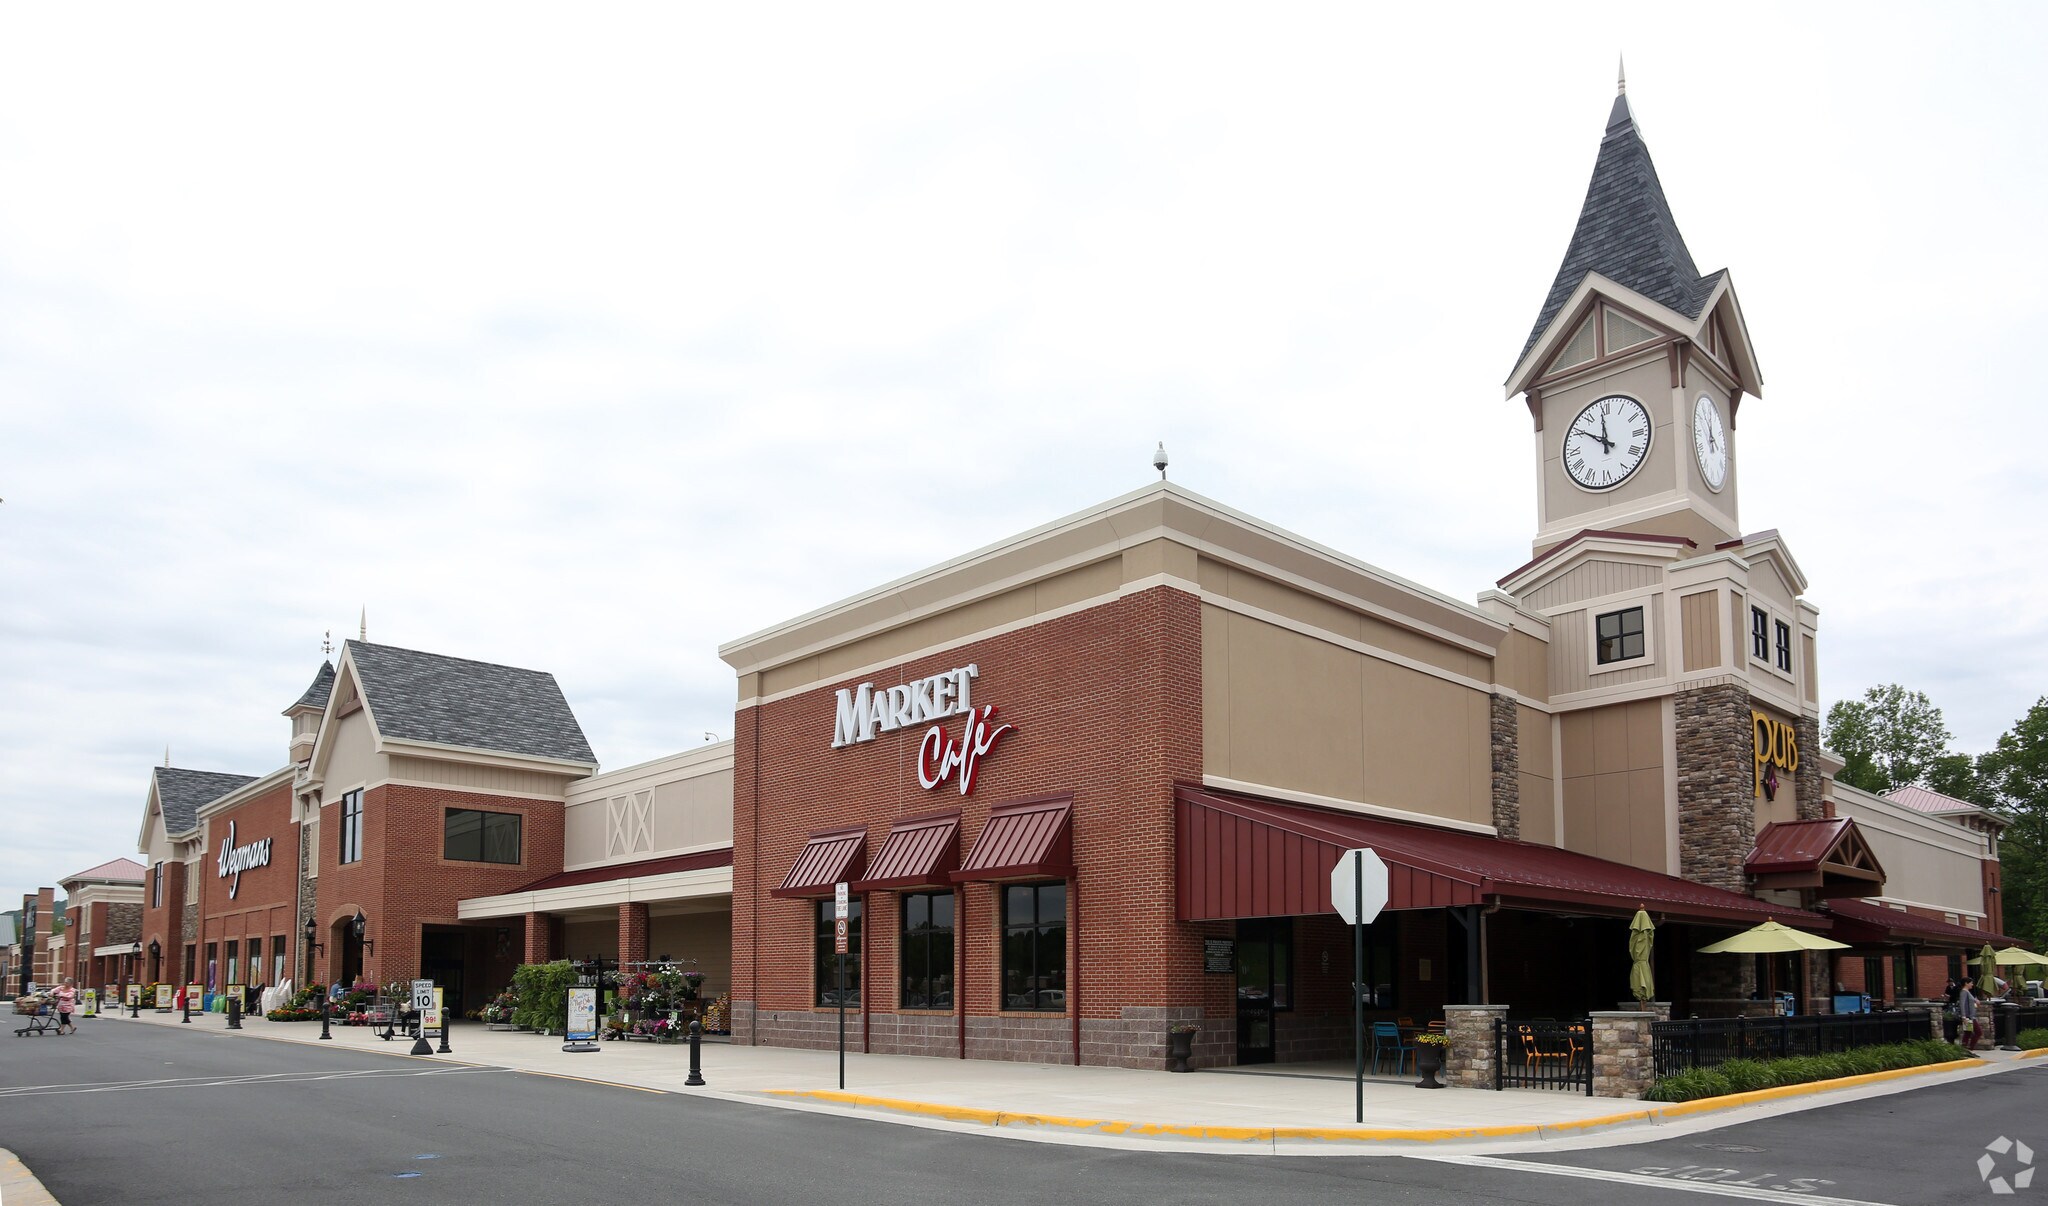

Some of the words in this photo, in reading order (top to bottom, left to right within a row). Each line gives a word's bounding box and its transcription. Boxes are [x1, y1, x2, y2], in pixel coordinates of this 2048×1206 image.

[1632, 428, 1644, 437] III
[831, 664, 979, 749] MARKET
[918, 704, 1019, 797] Café
[217, 820, 272, 900] Wegmans
[416, 995, 431, 1008] 10
[1629, 1165, 1837, 1193] STOP
